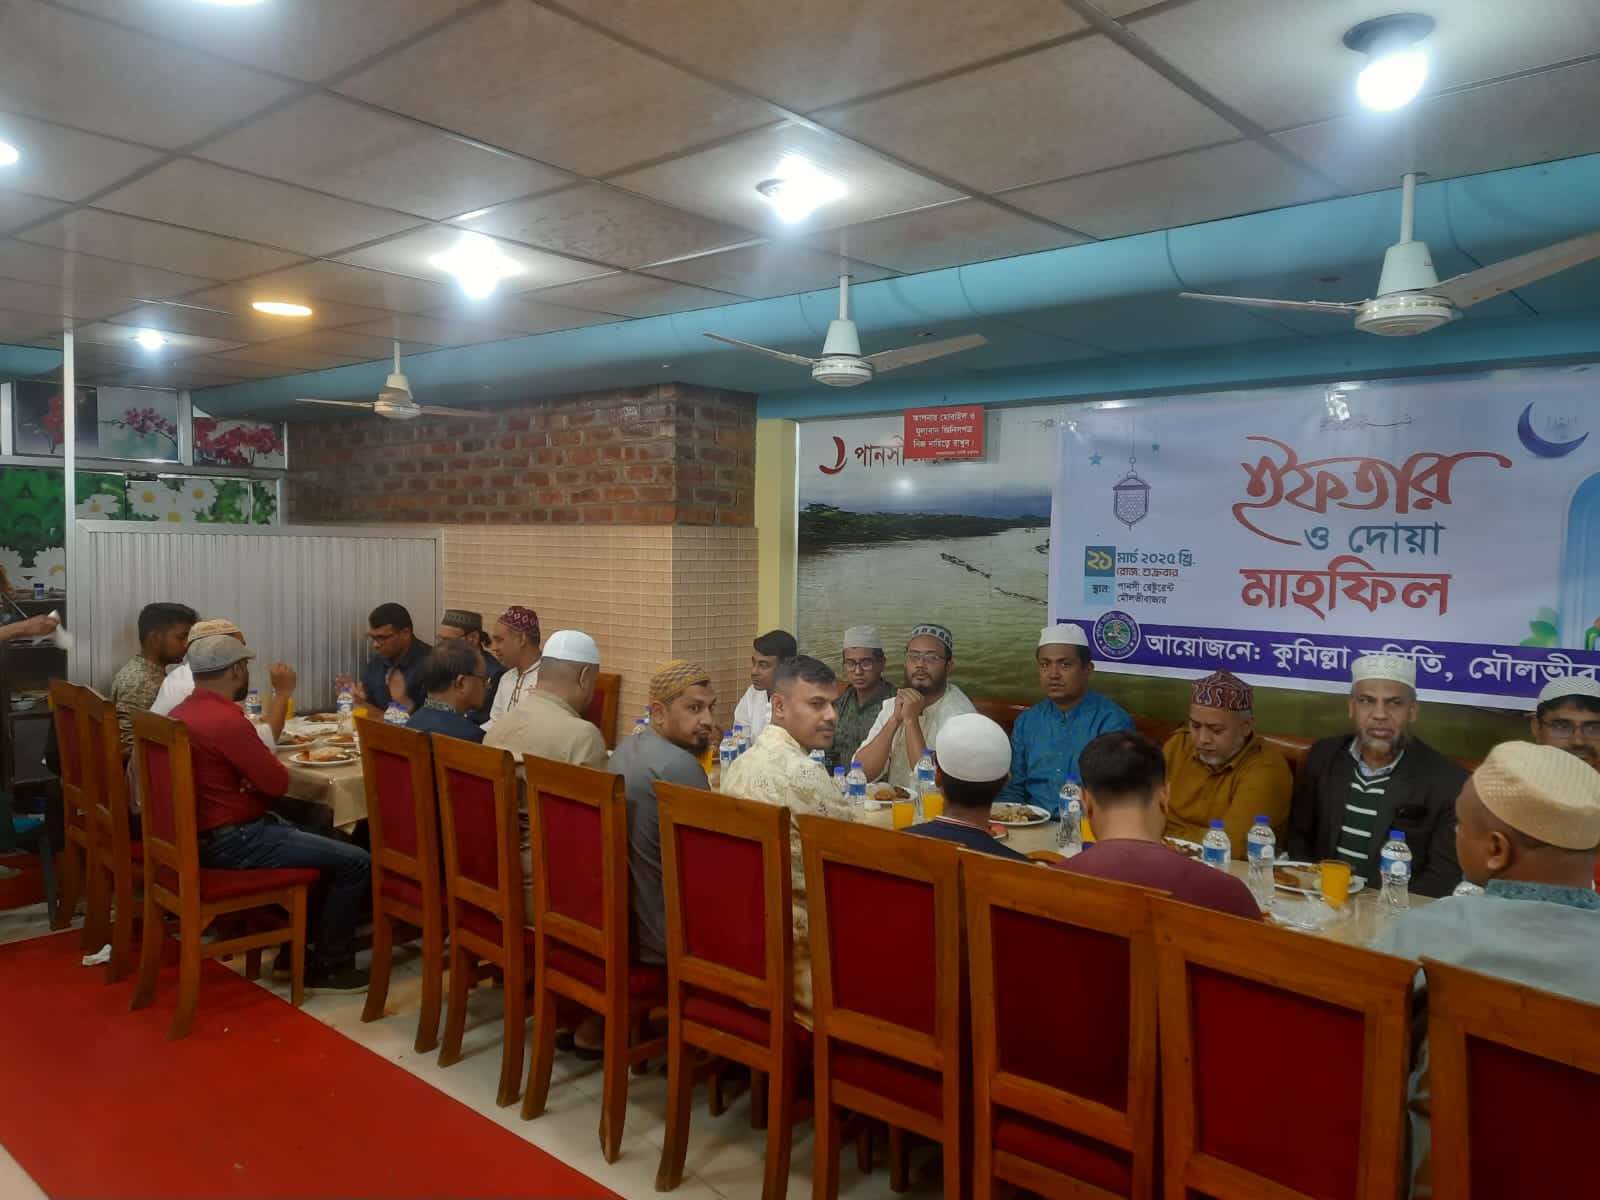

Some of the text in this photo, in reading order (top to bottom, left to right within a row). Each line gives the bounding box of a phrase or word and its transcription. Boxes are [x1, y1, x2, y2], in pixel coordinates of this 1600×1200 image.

[1231, 436, 1513, 546] ইফতার
[1304, 521, 1448, 555] ও দোয়া
[1087, 550, 1113, 570] ২১
[1117, 548, 1139, 565] মার্চ
[1141, 552, 1176, 565] ২০২৫
[1239, 555, 1453, 621] মাহফিল
[1144, 634, 1261, 662] আয়োজনে:
[1270, 637, 1355, 671] কুমিল্লা
